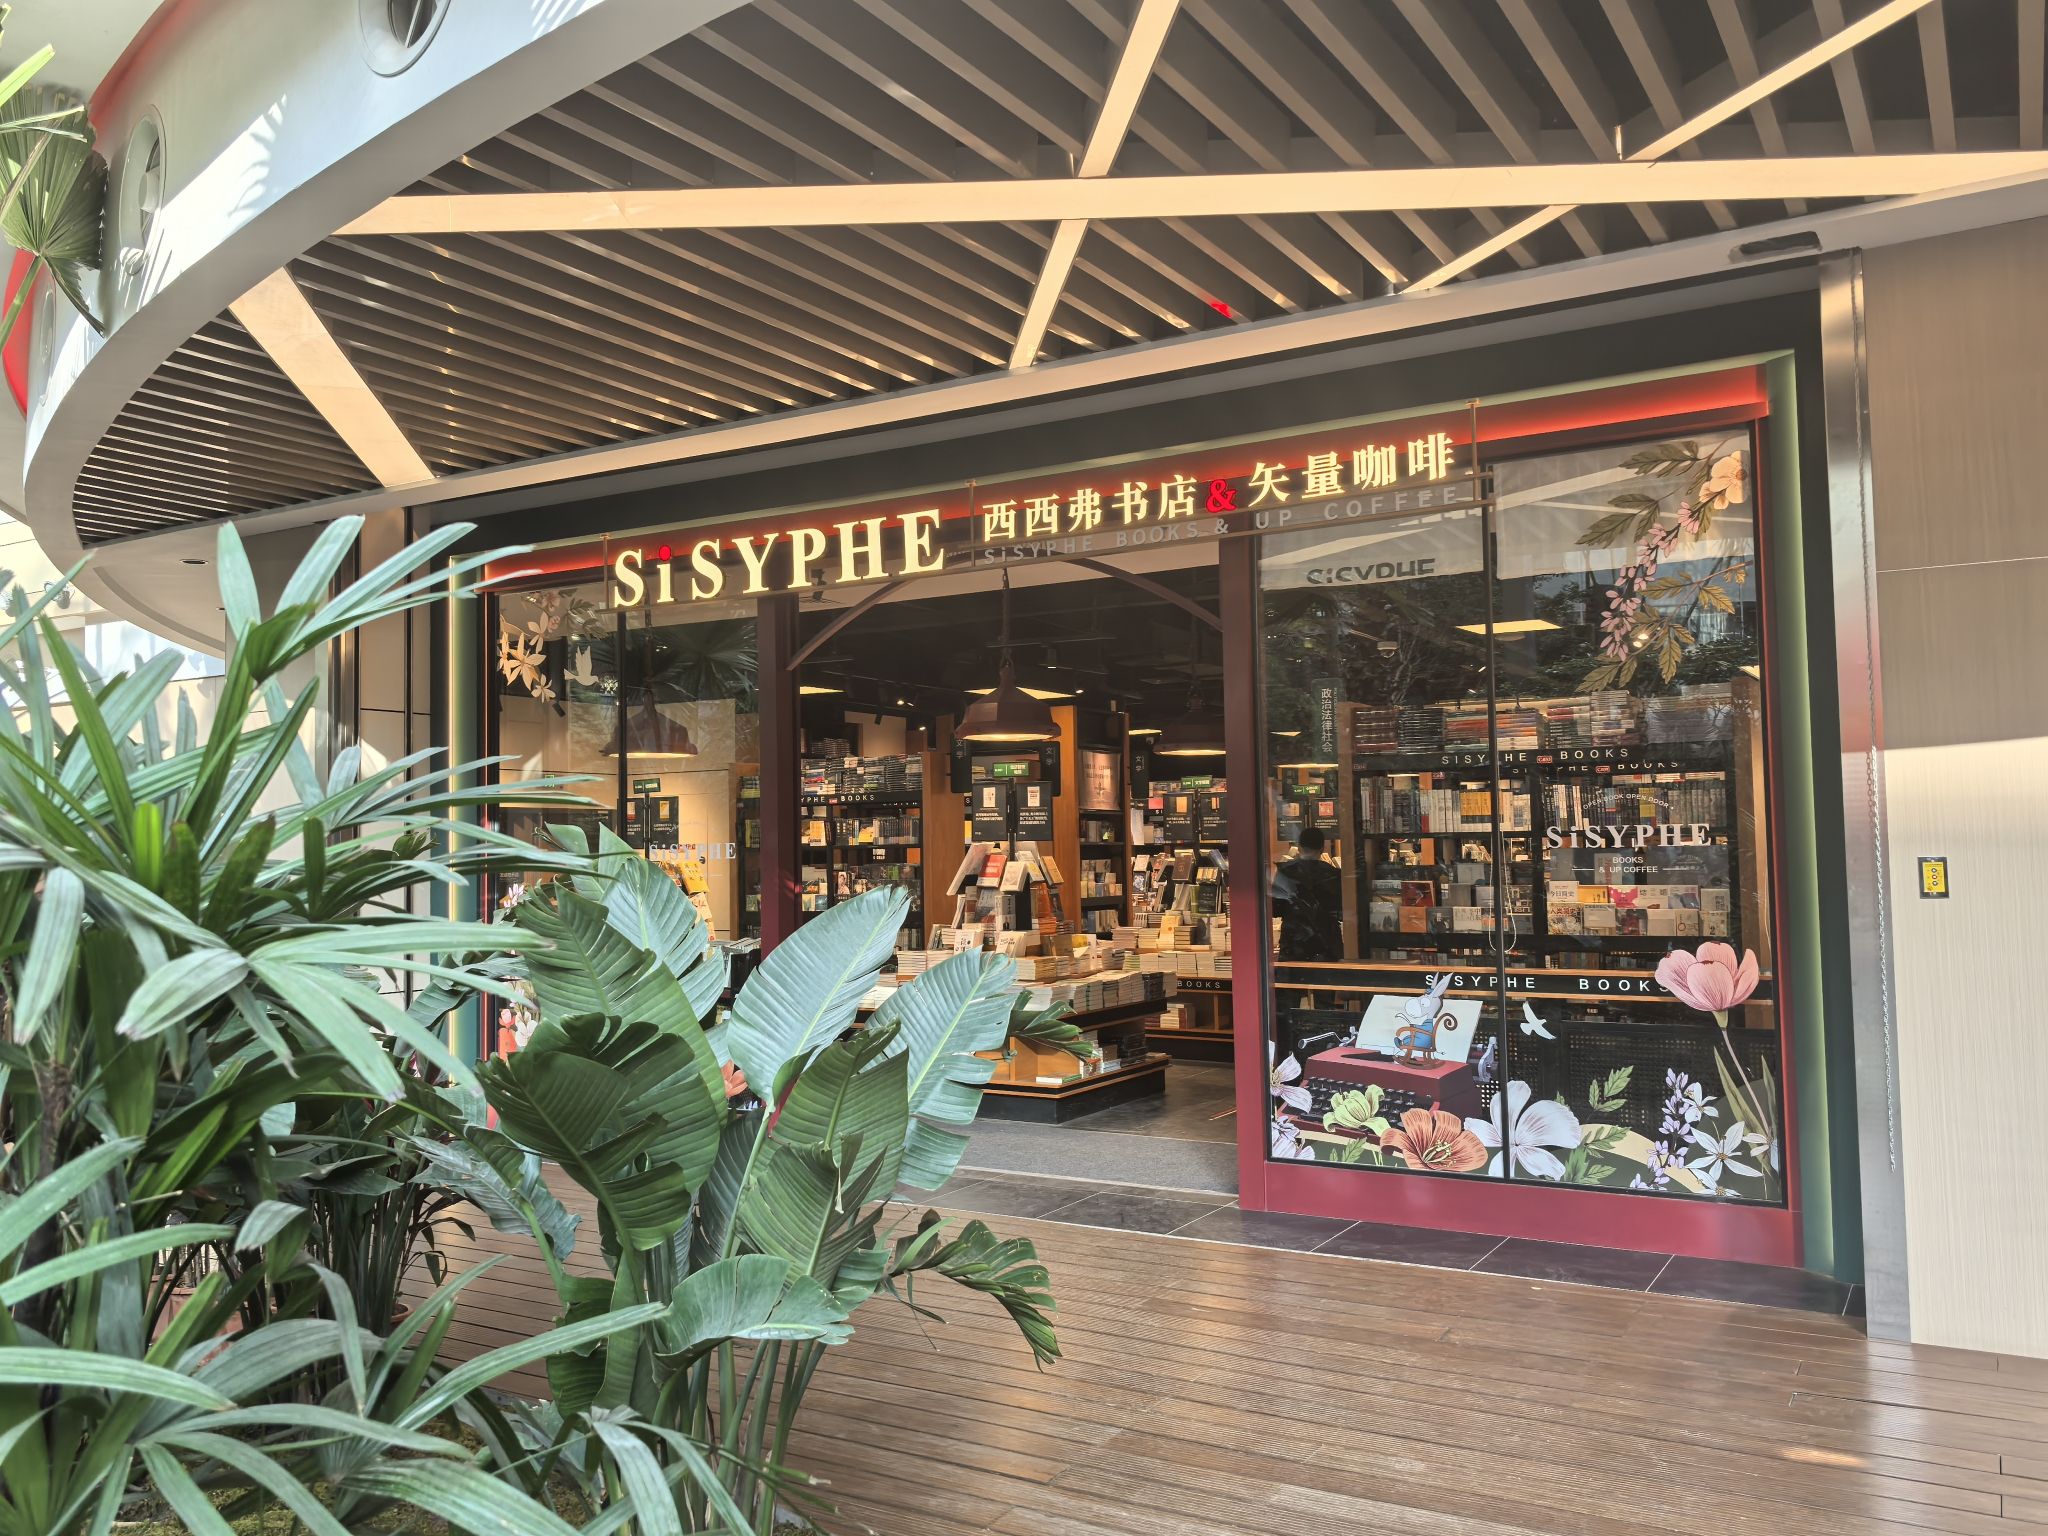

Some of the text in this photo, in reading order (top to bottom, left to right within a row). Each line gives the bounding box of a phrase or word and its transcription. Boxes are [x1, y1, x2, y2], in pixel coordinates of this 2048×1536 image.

[1116, 522, 1199, 547] BOOKS
[1214, 518, 1229, 535] &
[1255, 509, 1292, 530] UP
[1323, 487, 1459, 520] COFFEE
[614, 508, 945, 608] SiSYPHE
[1321, 688, 1333, 752] 政治法律社会
[1442, 752, 1527, 765] SISYHE
[1560, 748, 1629, 760] BOOKS
[841, 794, 875, 802] BOOKS
[1583, 799, 1602, 810] OPEN
[1648, 796, 1669, 809] DOOR
[1546, 823, 1712, 848] SiSYPHE
[1612, 856, 1644, 864] BOOKS
[1177, 980, 1221, 989] BOOKS
[1425, 974, 1535, 989] SSYPHE
